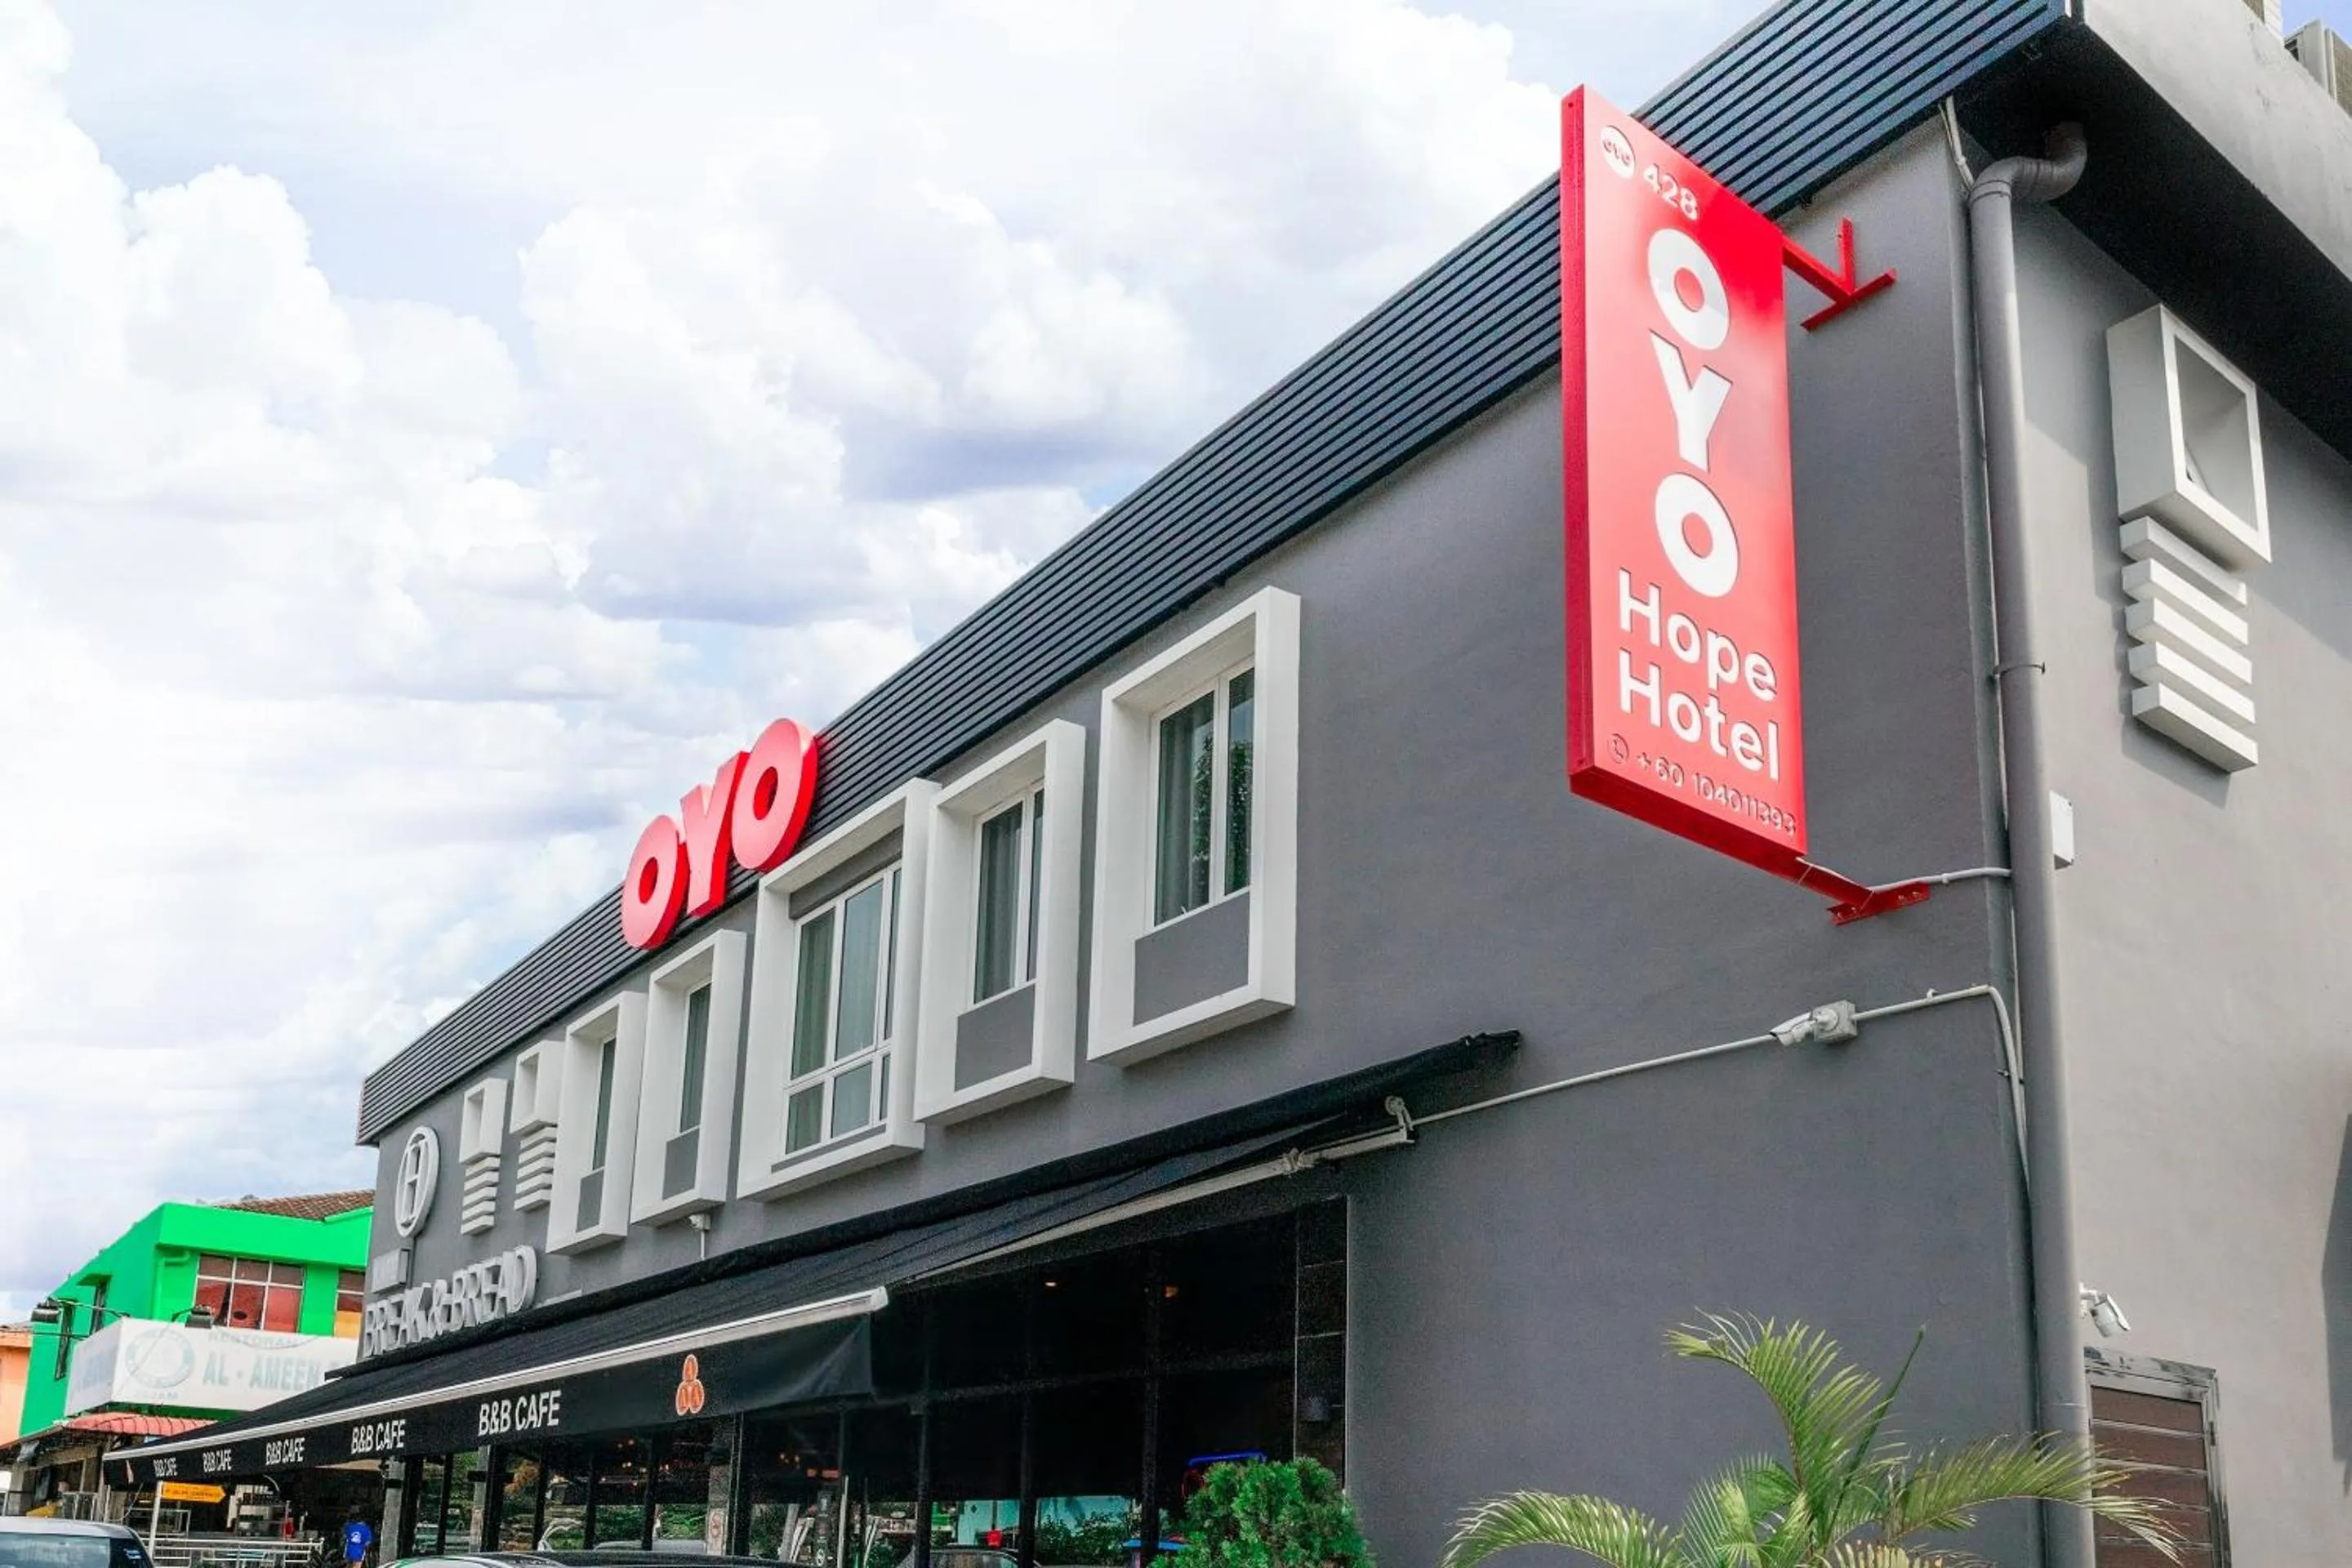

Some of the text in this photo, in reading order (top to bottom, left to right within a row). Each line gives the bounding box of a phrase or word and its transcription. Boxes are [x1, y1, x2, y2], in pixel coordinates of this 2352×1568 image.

[1642, 163, 1699, 221] 428
[1647, 228, 1739, 598] OYO
[1619, 567, 1777, 702] Hope
[1619, 648, 1780, 782] Hotel
[621, 717, 820, 951] OYO
[203, 1351, 229, 1386] AL
[351, 1419, 405, 1454] B&B CAFE
[478, 1390, 561, 1437] B&B CAFE
[283, 1437, 305, 1463] CAFE
